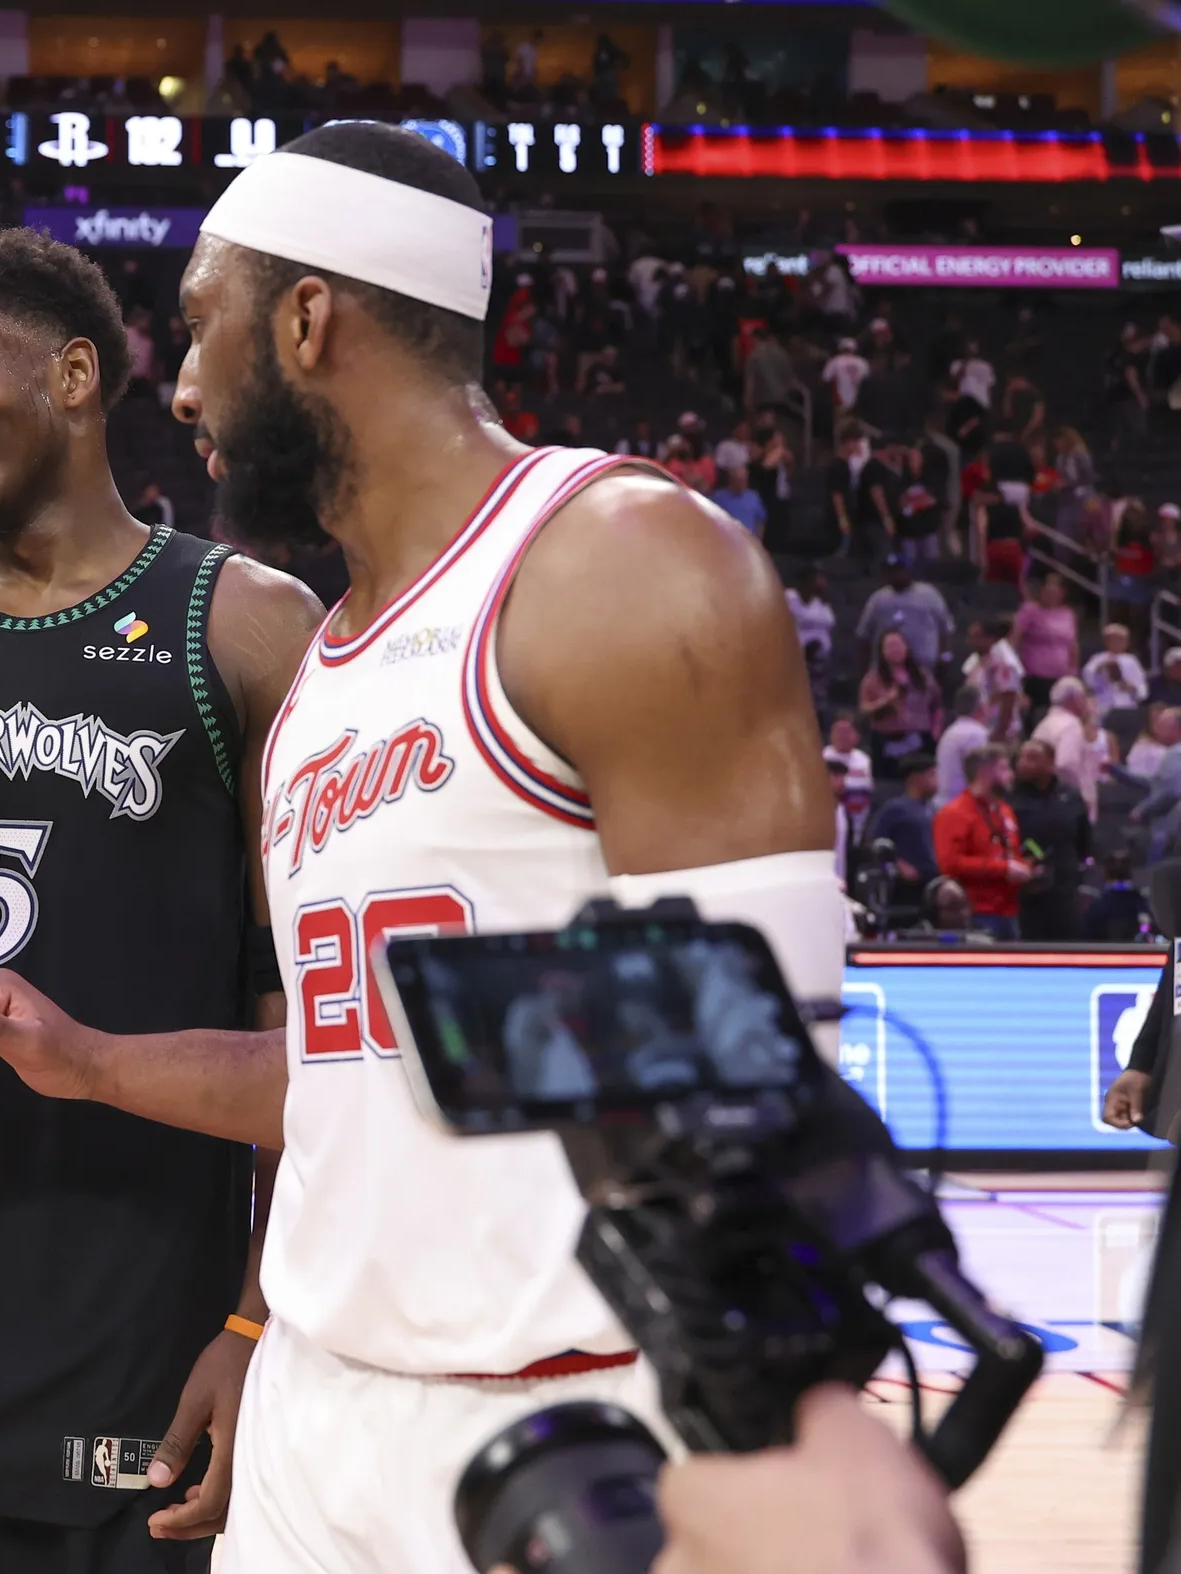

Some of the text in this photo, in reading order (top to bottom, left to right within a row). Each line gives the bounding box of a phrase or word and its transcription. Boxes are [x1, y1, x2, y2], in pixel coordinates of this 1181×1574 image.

[74, 208, 171, 247] xfinity
[935, 255, 1012, 277] ENERGY
[1013, 256, 1110, 278] PROVIDER
[83, 644, 173, 664] sezzle
[123, 1451, 136, 1462] 50
